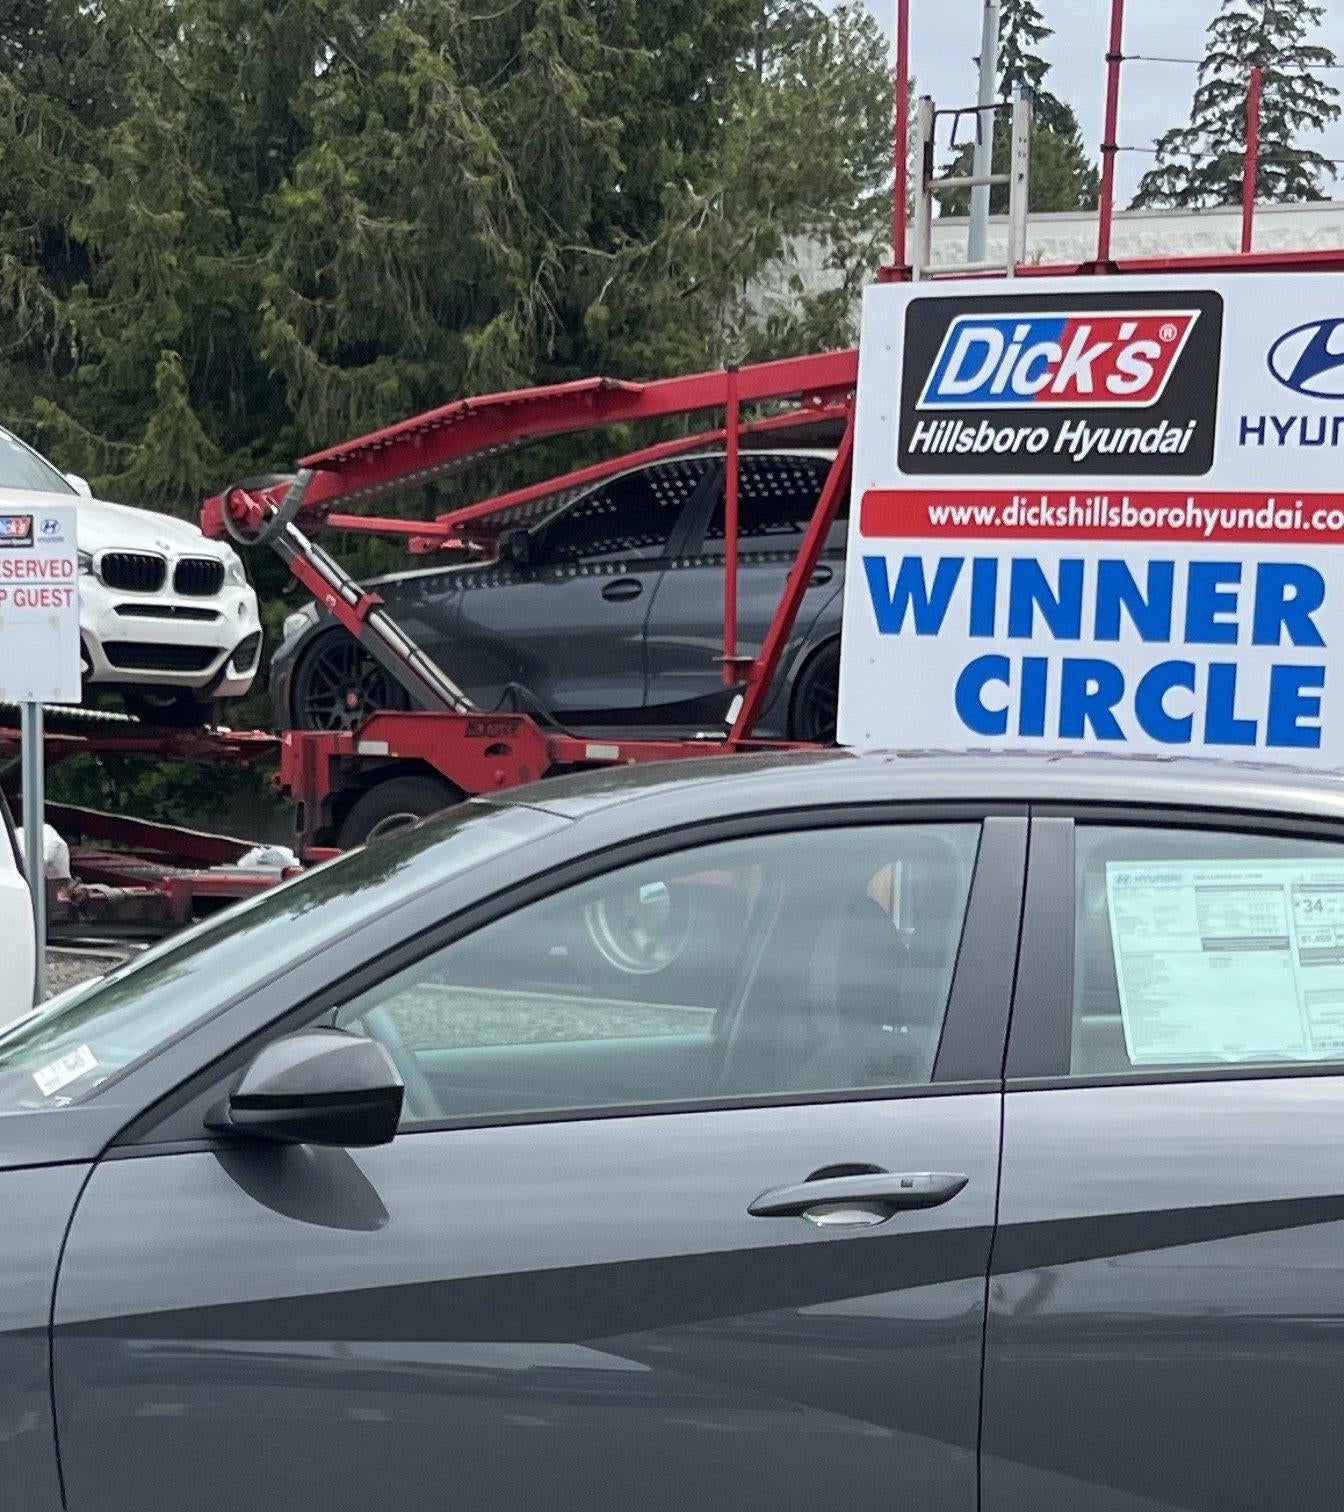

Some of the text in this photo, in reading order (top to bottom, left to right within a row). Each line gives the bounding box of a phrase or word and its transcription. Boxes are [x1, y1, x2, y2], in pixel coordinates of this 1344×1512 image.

[936, 321, 1163, 397] Dick's
[908, 419, 1197, 463] Hillsboro Hyundai
[13, 588, 74, 608] GUEST
[954, 653, 1328, 750] CIRCLE
